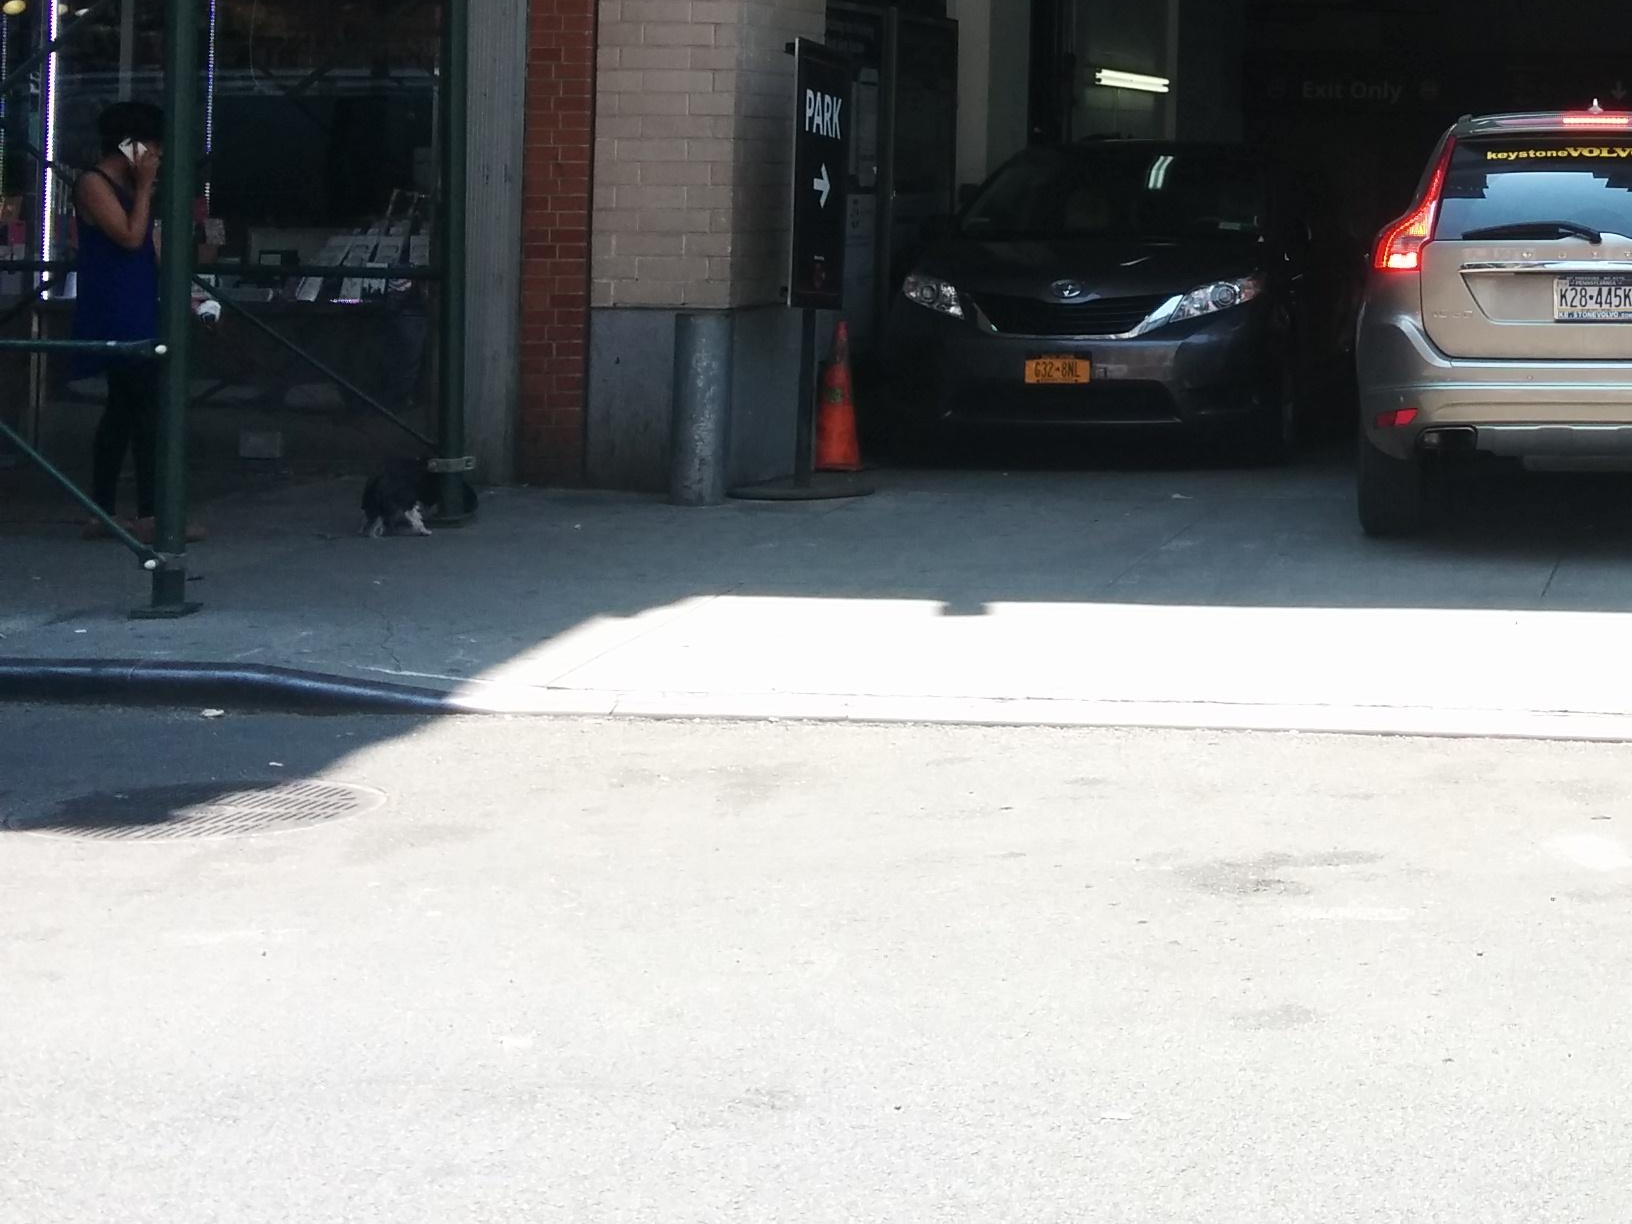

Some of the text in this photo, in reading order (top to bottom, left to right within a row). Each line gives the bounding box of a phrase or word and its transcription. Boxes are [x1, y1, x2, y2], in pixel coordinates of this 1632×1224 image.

[1303, 80, 1401, 105] Exit Only
[805, 88, 842, 140] PARK
